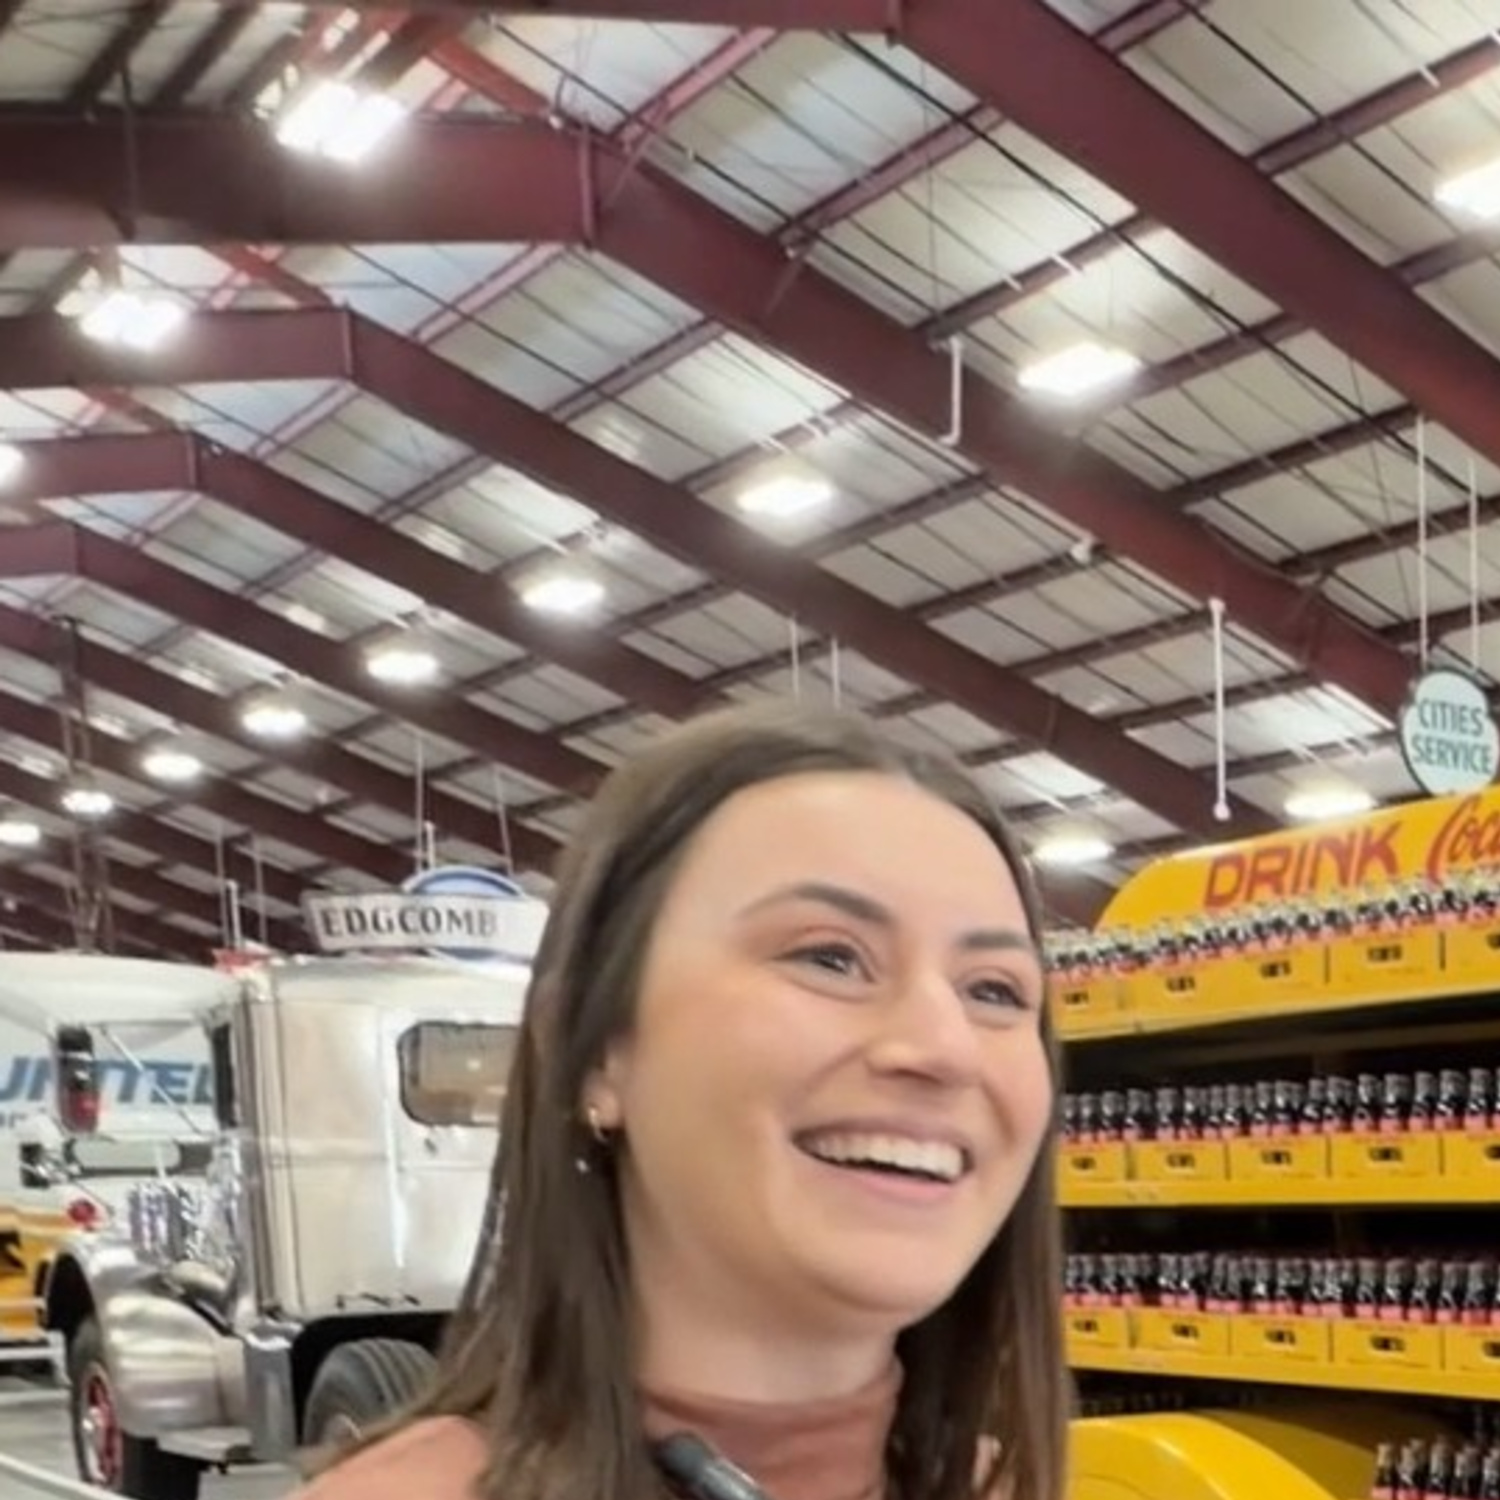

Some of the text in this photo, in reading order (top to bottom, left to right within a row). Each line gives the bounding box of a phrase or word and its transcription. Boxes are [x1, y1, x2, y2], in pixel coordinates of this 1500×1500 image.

[1418, 699, 1484, 738] CITIES
[1411, 733, 1492, 774] SERVICE
[1204, 821, 1402, 910] DRINK
